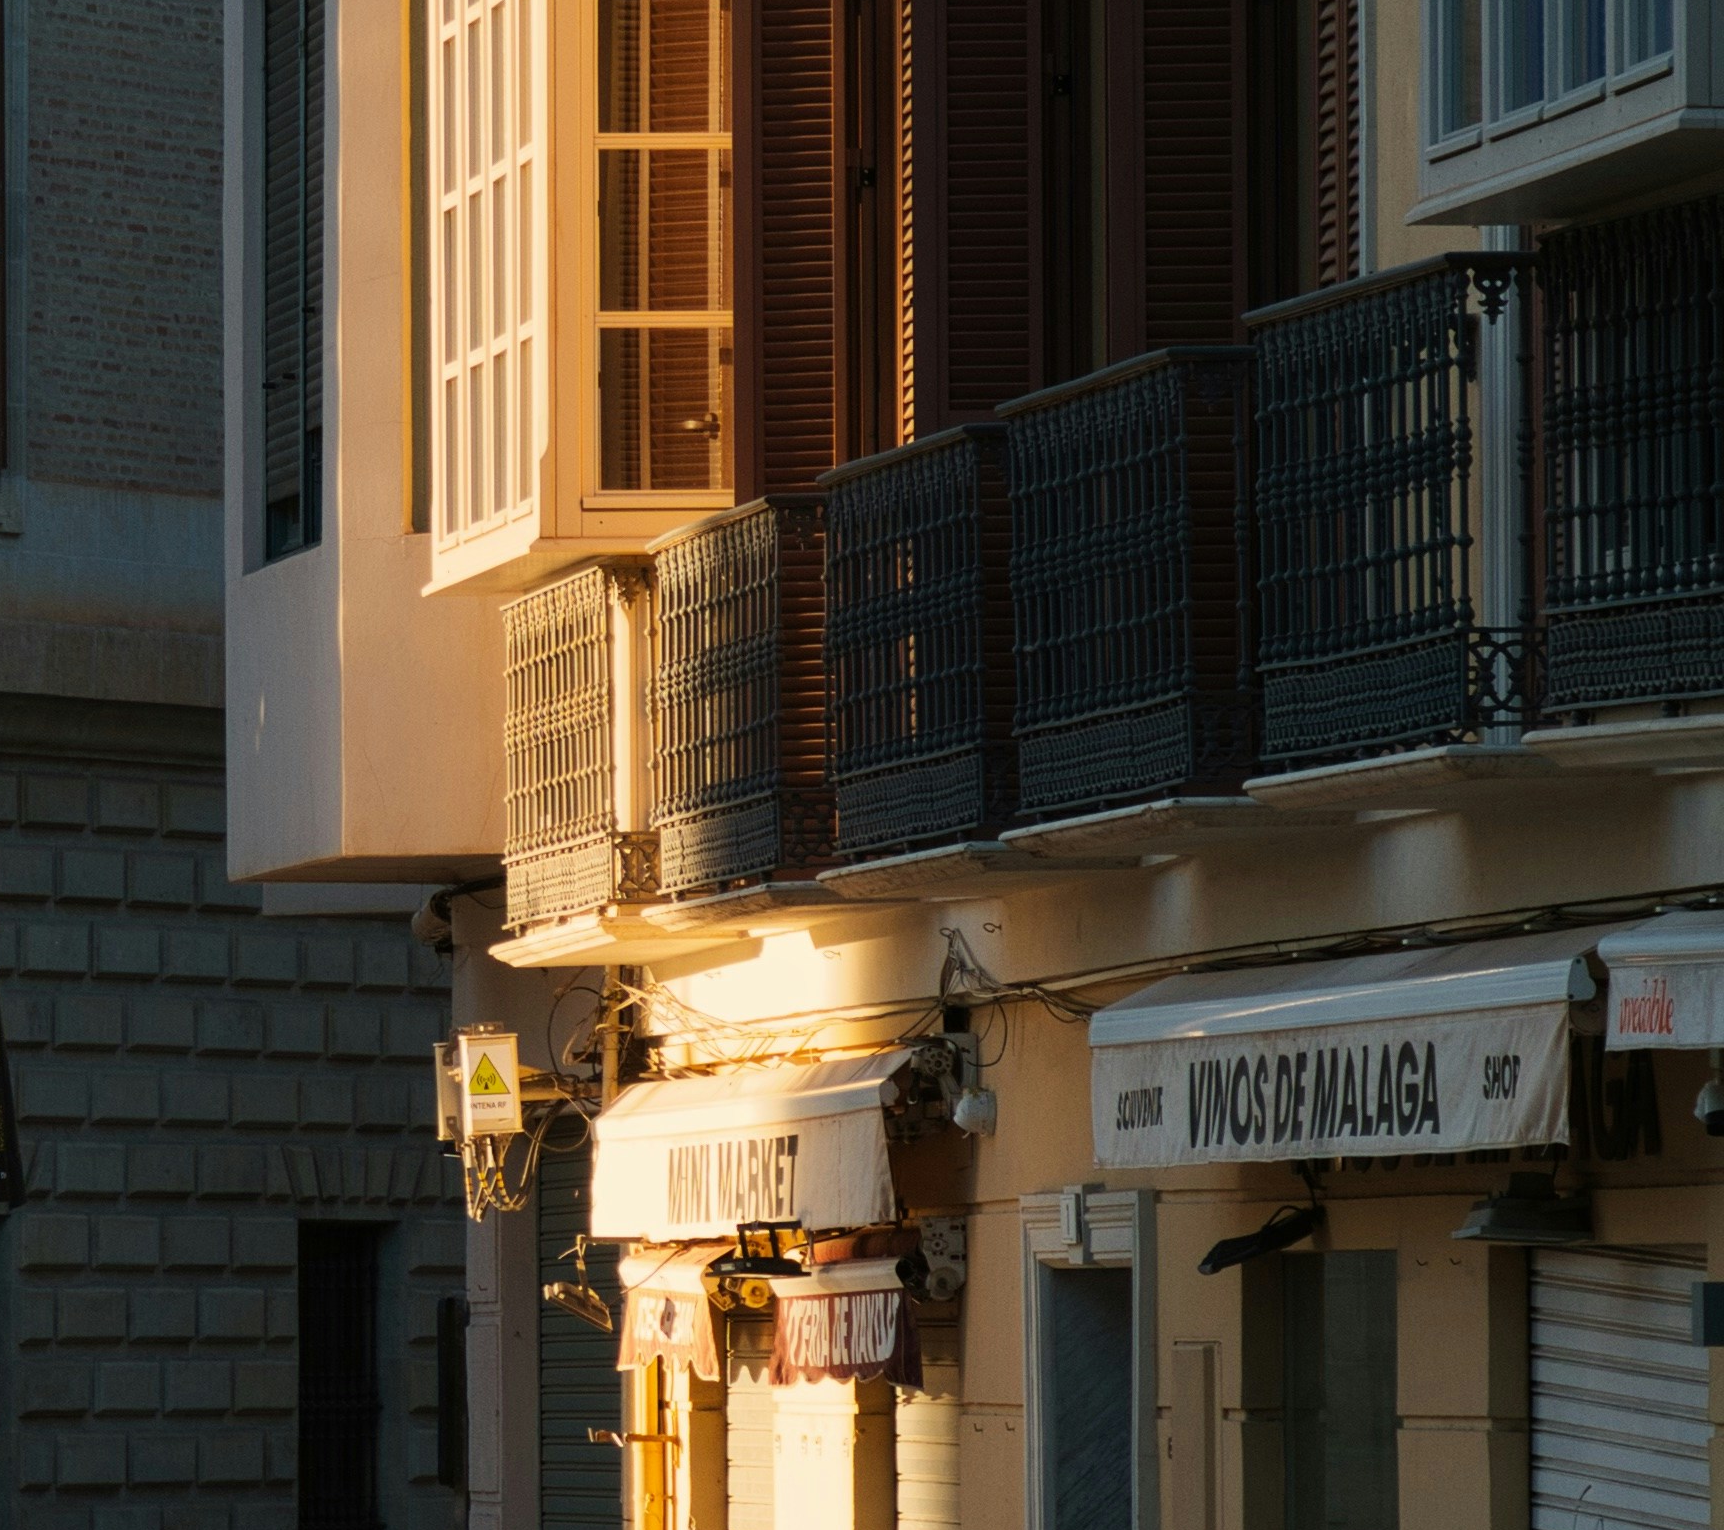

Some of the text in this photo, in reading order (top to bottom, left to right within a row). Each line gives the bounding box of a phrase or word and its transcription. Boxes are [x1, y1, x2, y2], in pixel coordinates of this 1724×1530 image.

[1189, 1054, 1268, 1149] VINOS
[1272, 1051, 1307, 1144] DE
[1309, 1040, 1441, 1140] MALAGA
[1482, 1053, 1521, 1101] SHOP
[667, 1134, 799, 1225] MINI MARKET
[832, 1295, 850, 1366] DE
